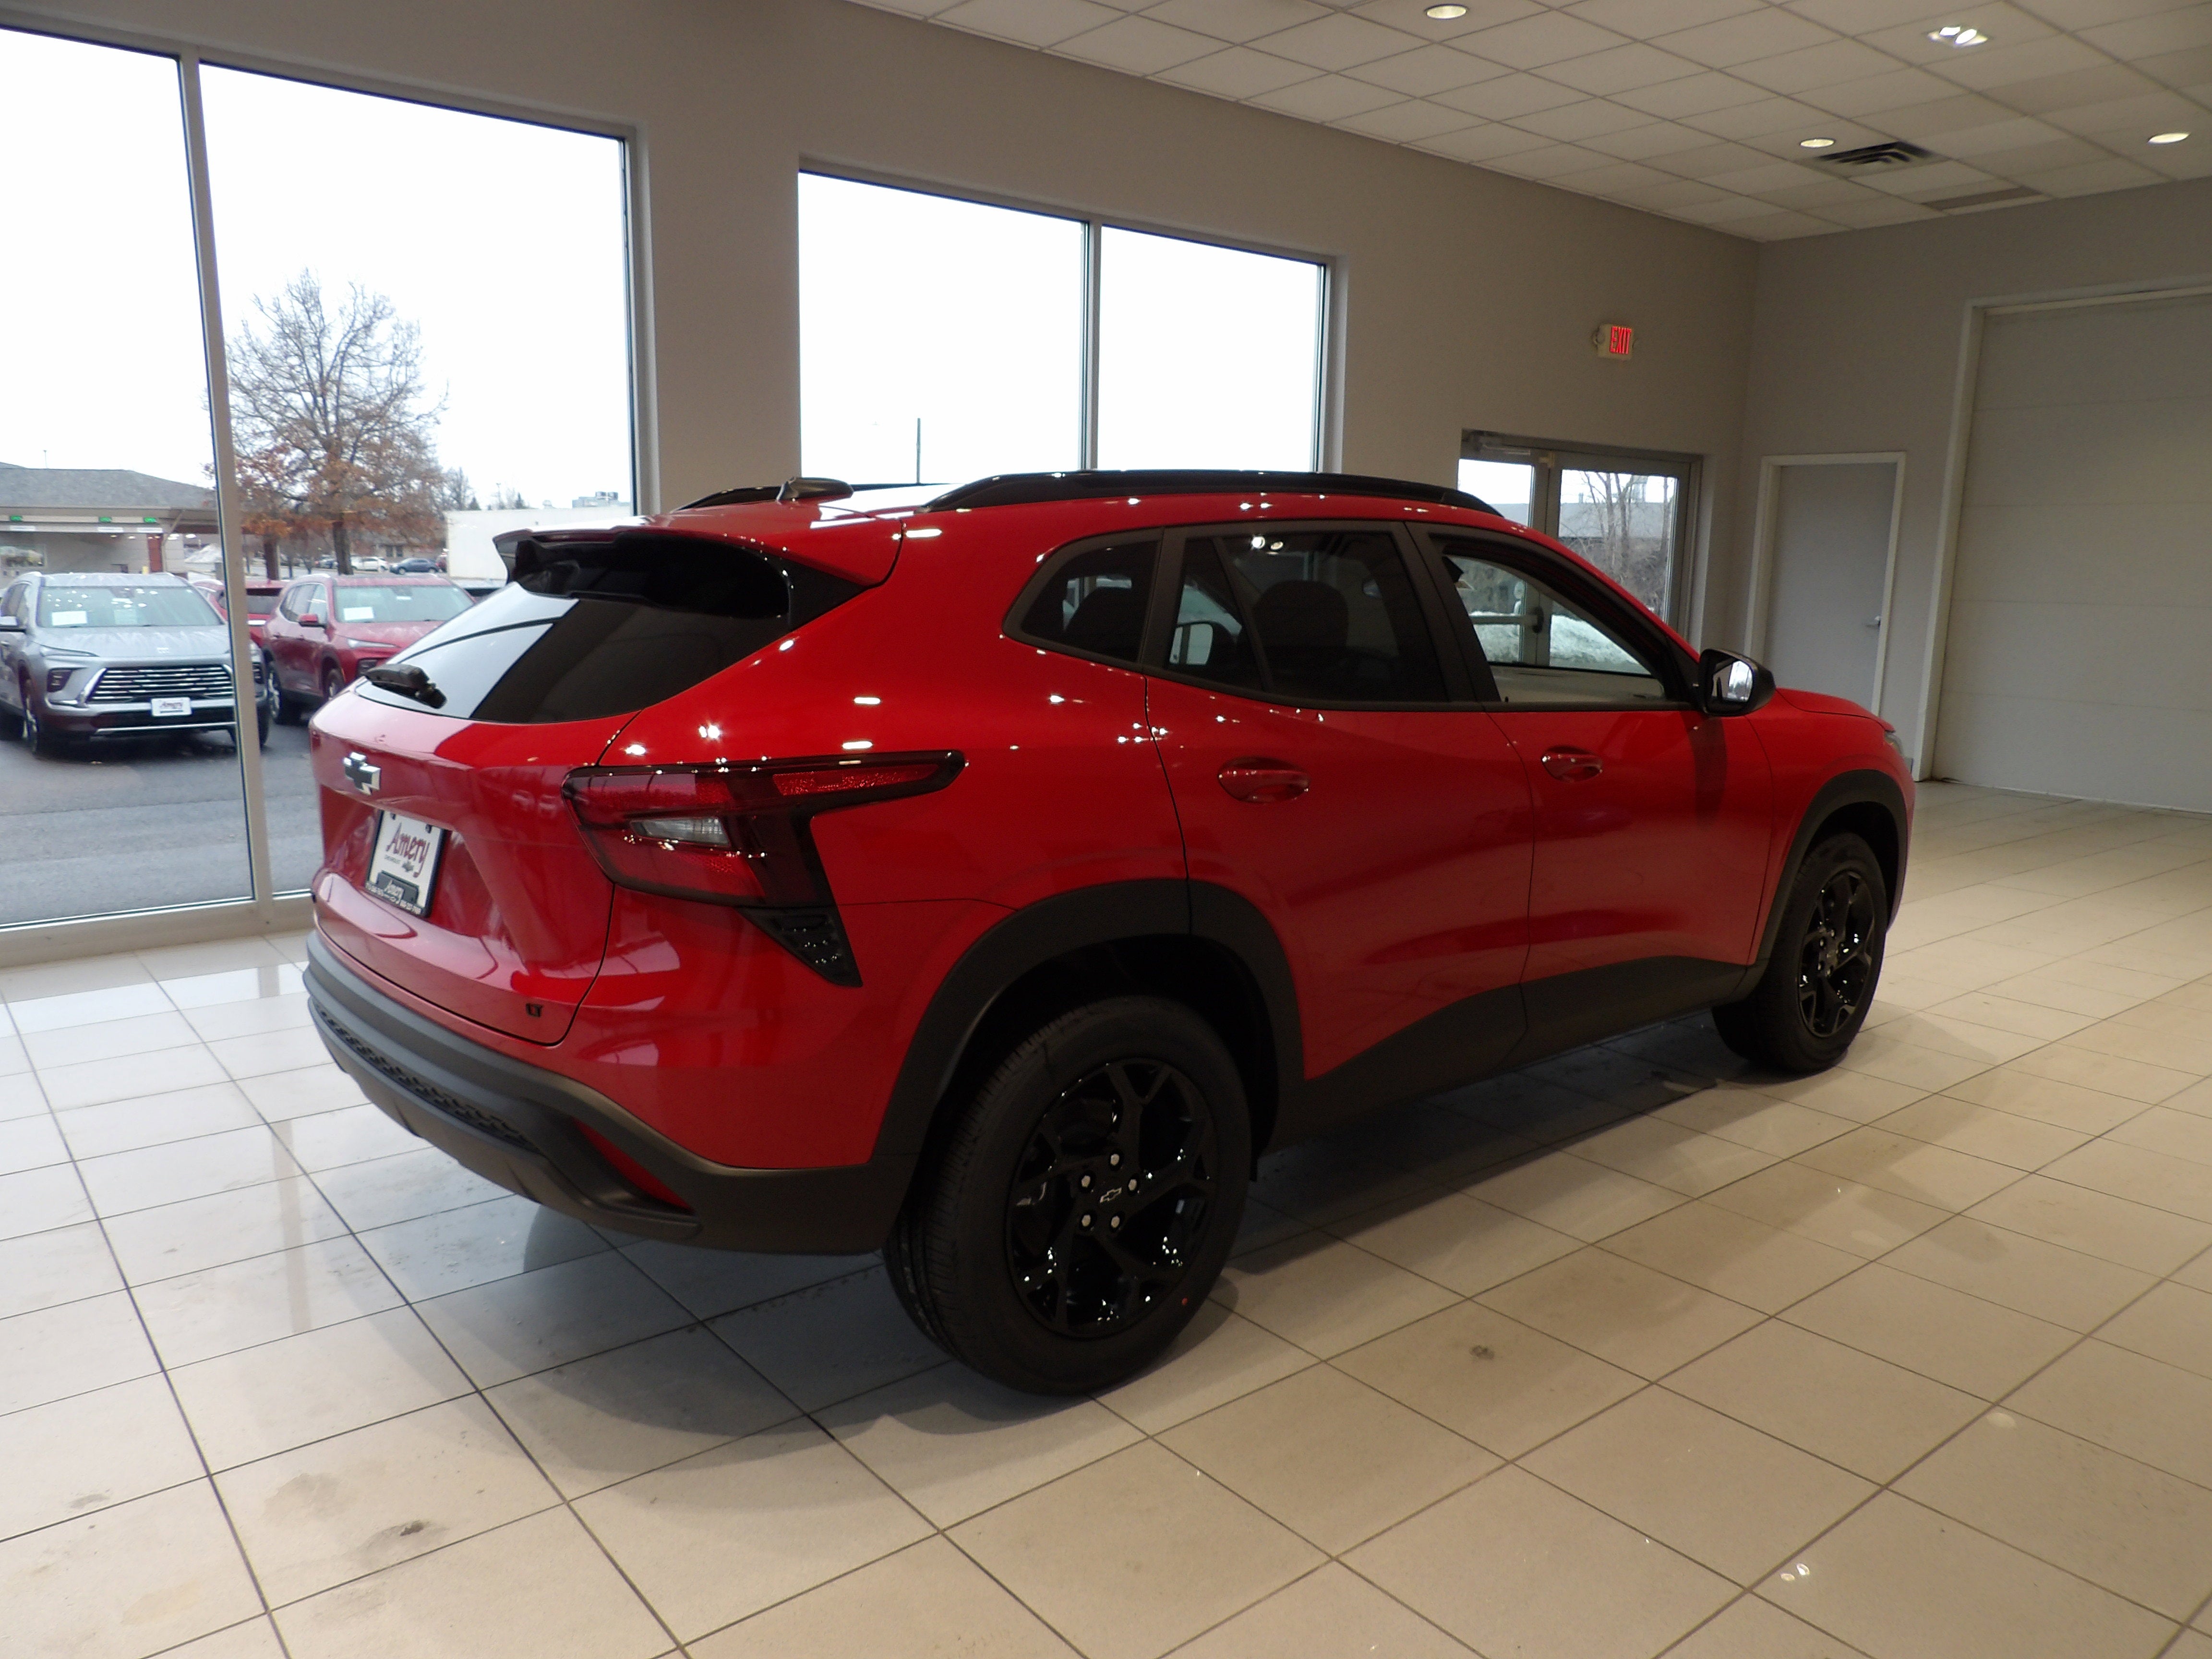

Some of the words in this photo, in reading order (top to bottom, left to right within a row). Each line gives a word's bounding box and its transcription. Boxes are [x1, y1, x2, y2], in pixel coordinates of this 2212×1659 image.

[1610, 326, 1632, 354] EXIT
[386, 822, 430, 878] Amery
[526, 1003, 543, 1017] LT
